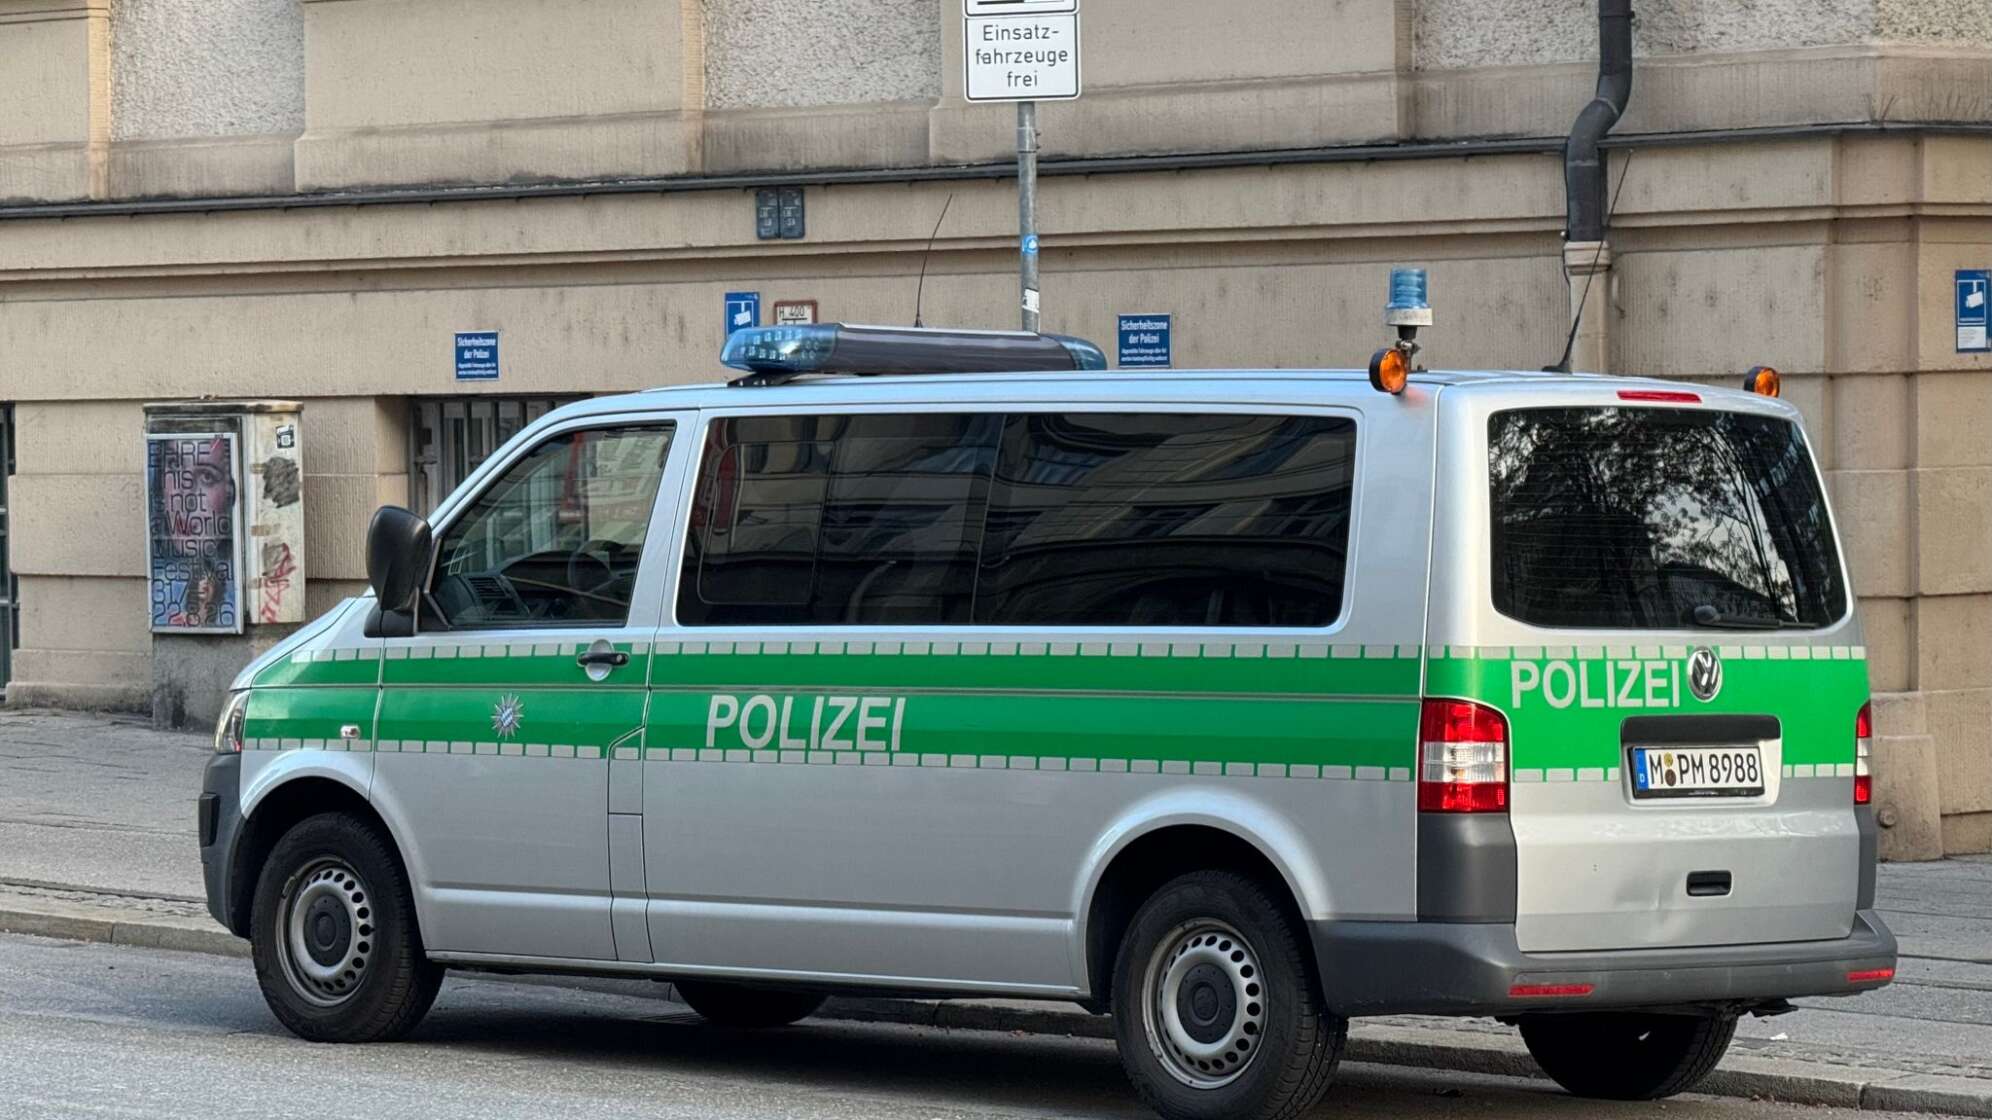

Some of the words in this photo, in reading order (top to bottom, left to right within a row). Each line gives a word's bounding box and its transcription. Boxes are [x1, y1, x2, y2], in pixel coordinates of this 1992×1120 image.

[982, 24, 1060, 41] Einsatz-
[975, 48, 1069, 67] fahrzeuge
[1006, 70, 1038, 88] frei
[1120, 319, 1168, 331] Sicherheitszone
[1128, 333, 1139, 344] der
[1140, 332, 1160, 344] Polizei
[170, 488, 207, 512] not
[1510, 660, 1680, 708] POLIZEI
[706, 695, 906, 751] POLIZEI
[1648, 753, 1664, 785] M
[1676, 753, 1706, 785] PM
[1708, 753, 1758, 784] 8988
